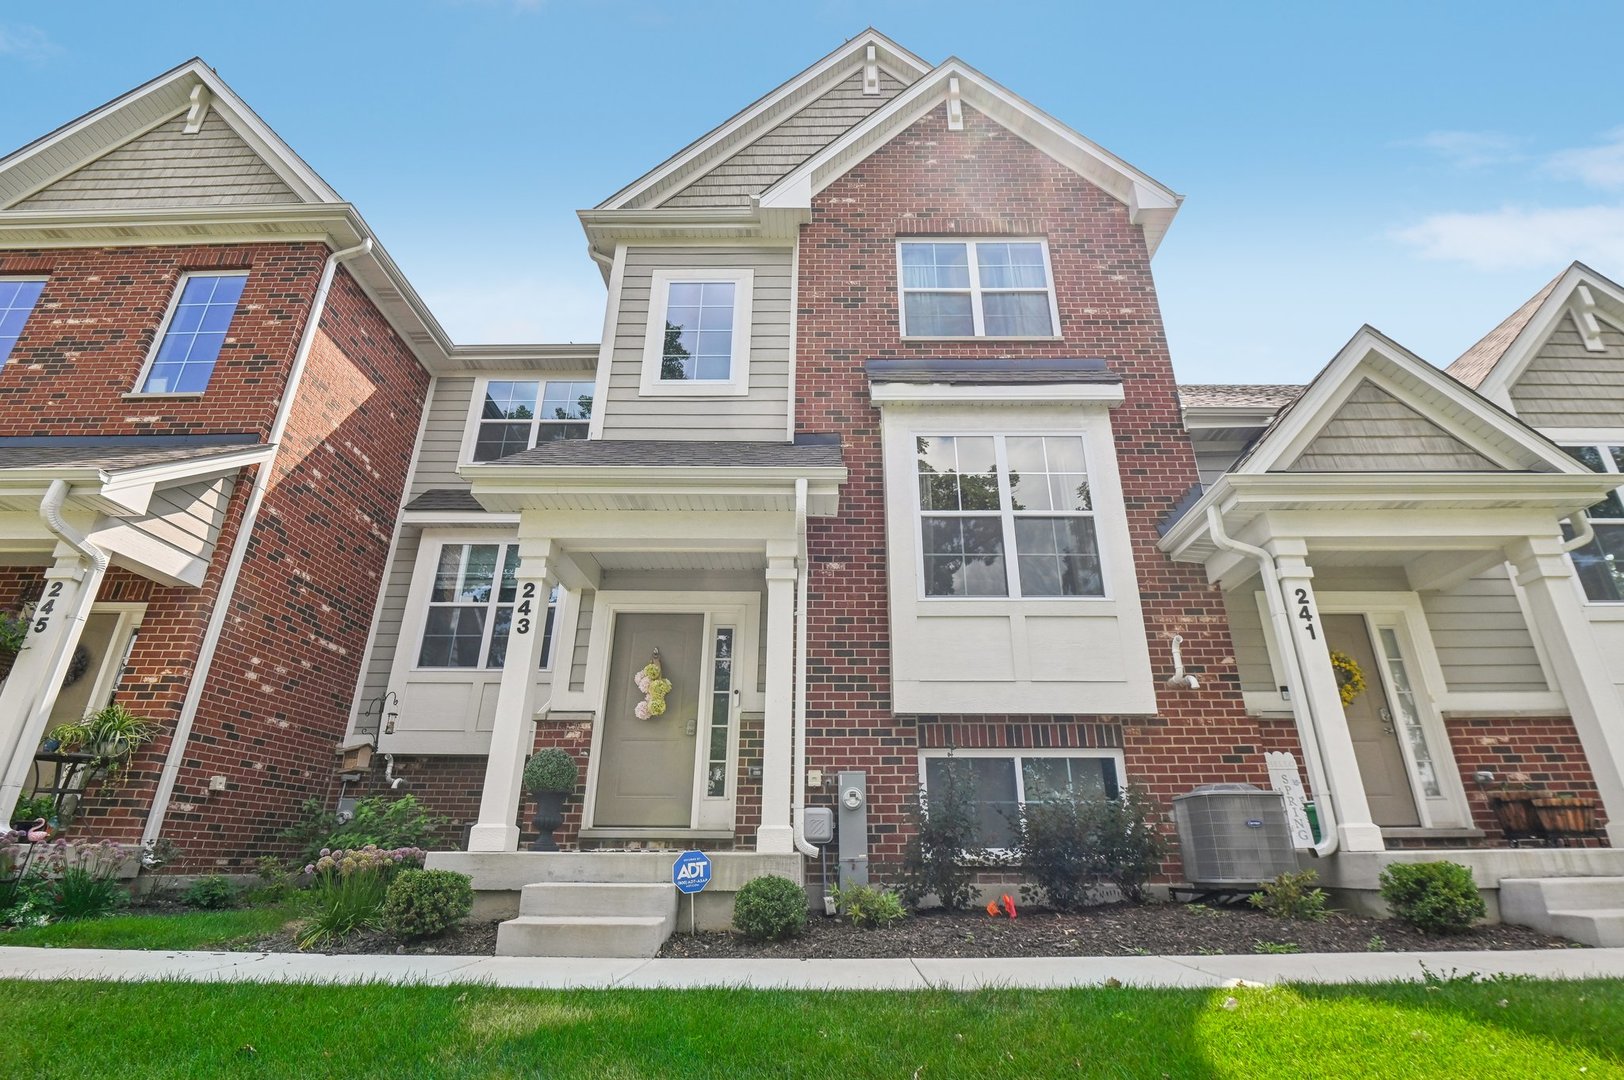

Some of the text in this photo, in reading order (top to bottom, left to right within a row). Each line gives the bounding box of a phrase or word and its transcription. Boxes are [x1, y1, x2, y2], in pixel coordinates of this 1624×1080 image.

[34, 581, 64, 633] 245
[517, 582, 535, 634] 243
[1295, 588, 1316, 640] 241
[1281, 774, 1309, 841] SPRING
[677, 861, 708, 880] ADT
